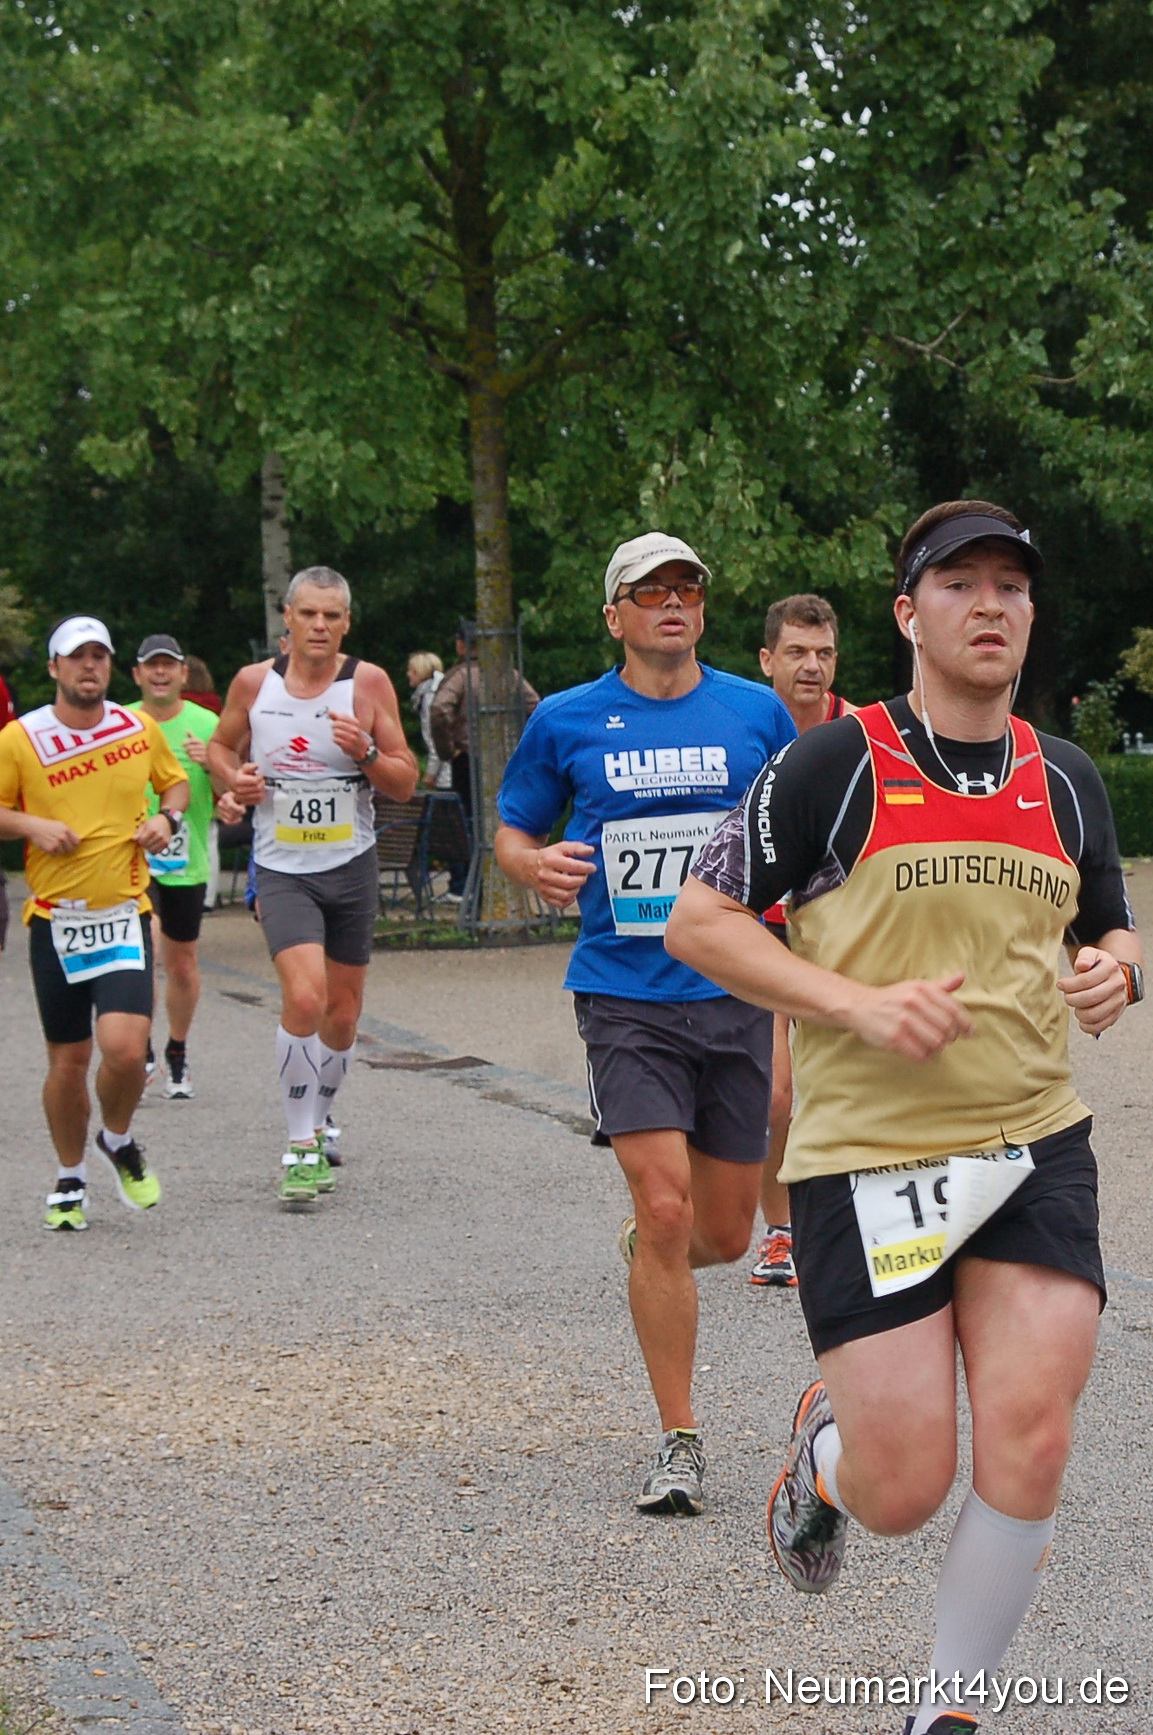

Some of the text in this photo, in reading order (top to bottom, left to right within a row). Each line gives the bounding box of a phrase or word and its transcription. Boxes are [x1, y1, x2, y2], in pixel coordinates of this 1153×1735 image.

[47, 759, 98, 788] MAX
[604, 746, 728, 778] HUBER
[633, 773, 724, 786] TECHNOLOGY
[633, 788, 662, 799] WASTE
[664, 786, 692, 797] WATER
[289, 797, 336, 824] 481
[758, 769, 777, 864] ARMOUR
[302, 830, 327, 842] Fritz
[604, 826, 710, 844] PARTL Neumarkt
[618, 845, 705, 891] 277
[895, 855, 1070, 909] DEUTSCHLAND
[63, 919, 130, 953] 2907
